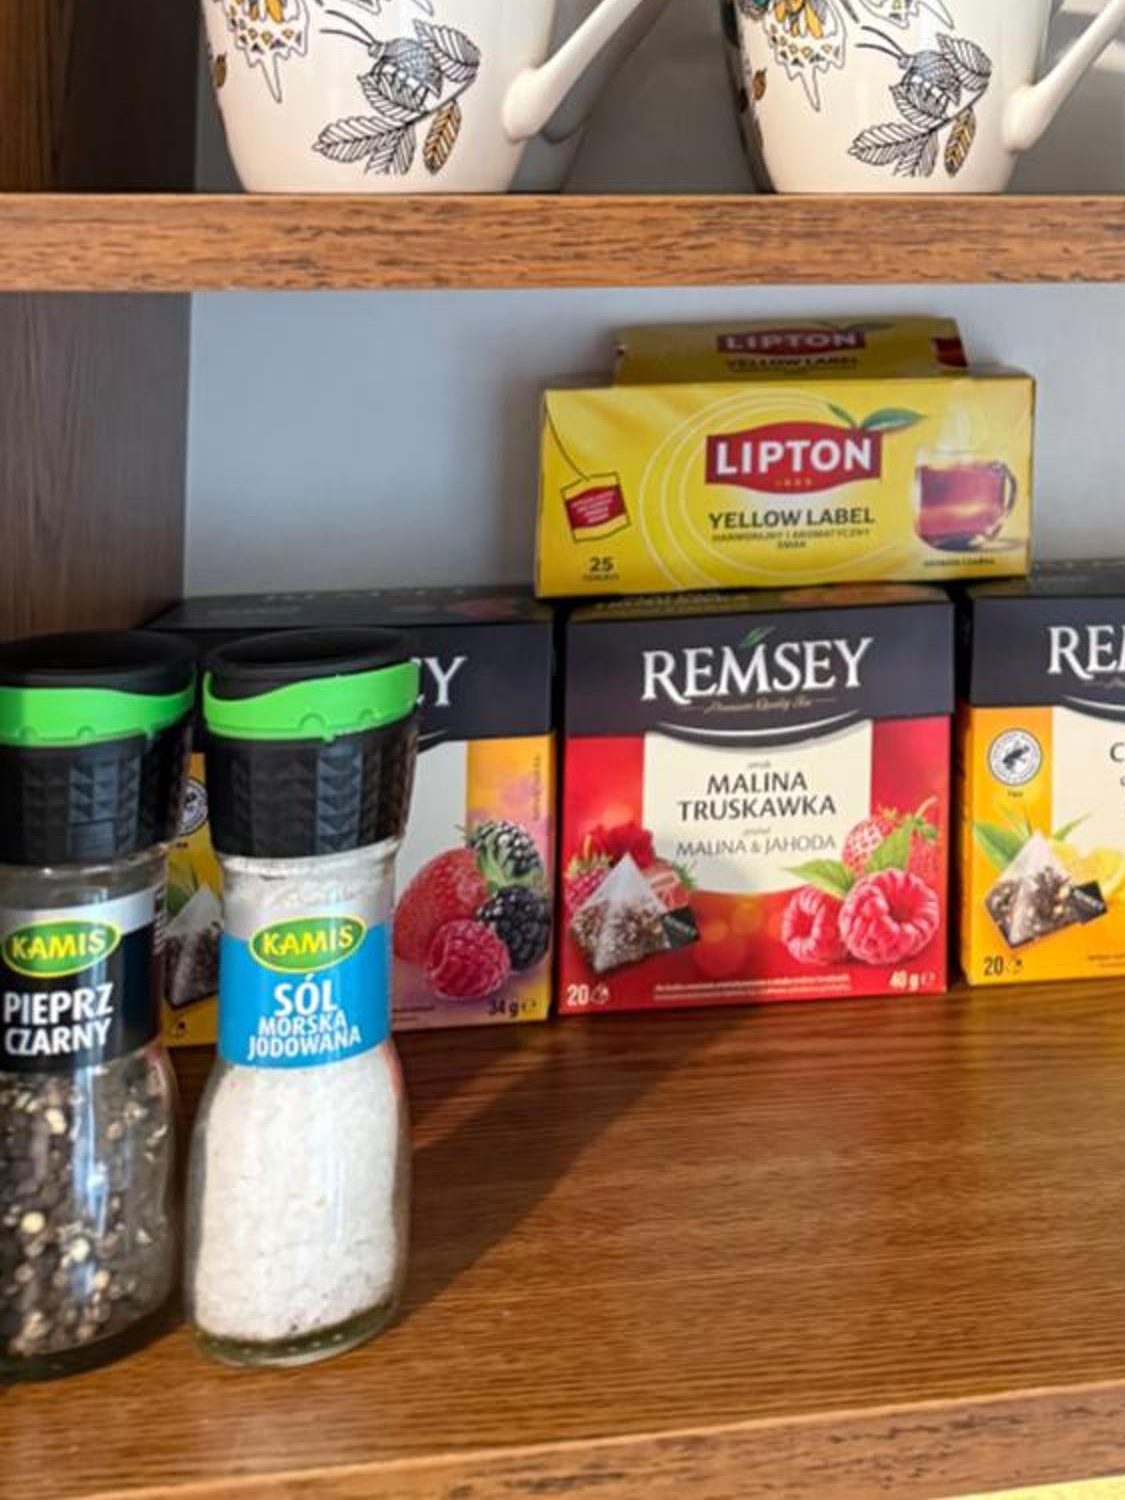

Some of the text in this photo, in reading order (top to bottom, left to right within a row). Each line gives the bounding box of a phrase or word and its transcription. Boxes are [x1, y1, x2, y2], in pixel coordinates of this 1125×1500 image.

[725, 332, 857, 350] LIPTON
[716, 438, 872, 475] LIPTON
[708, 506, 876, 530] YELLOW LABEL
[589, 556, 614, 572] 25
[641, 637, 874, 705] REMSEY
[706, 771, 809, 795] MALINA
[677, 795, 837, 822] TRUSKAWKA
[676, 833, 837, 857] MALINA & JAHODA
[11, 927, 106, 961] KAMIS
[262, 924, 355, 957] KAMIS
[983, 955, 1005, 977] 20
[4, 982, 114, 1027] PIEPRZ
[273, 973, 338, 1018] SÓL
[567, 983, 589, 1006] 20
[4, 1017, 111, 1057] CZARNY
[258, 1011, 347, 1038] MORSKA
[247, 1027, 362, 1061] JODOWANA
